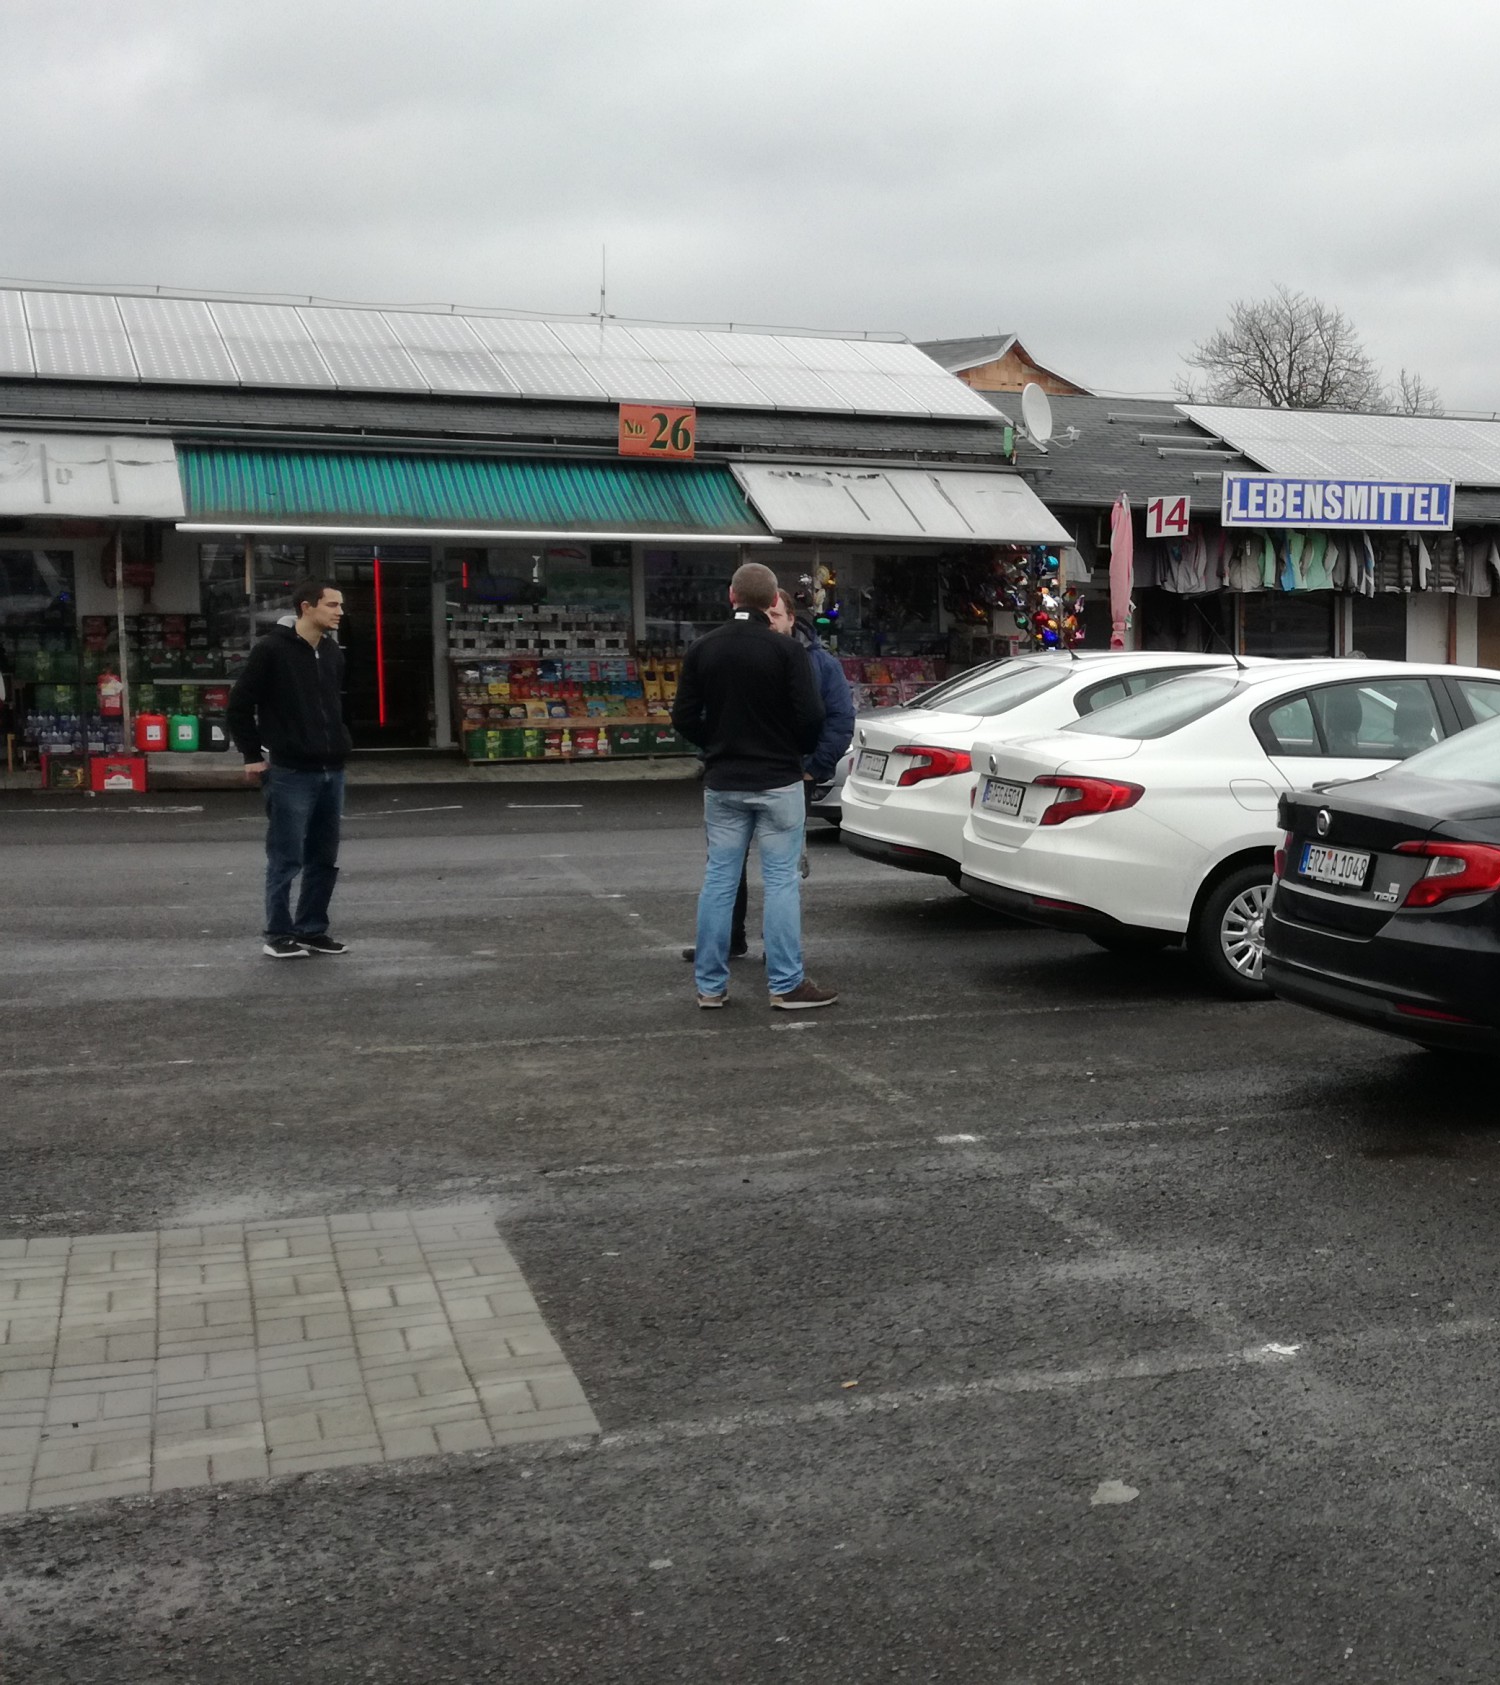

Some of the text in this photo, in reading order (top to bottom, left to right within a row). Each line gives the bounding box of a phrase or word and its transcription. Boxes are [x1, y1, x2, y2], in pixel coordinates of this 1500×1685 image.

[623, 412, 692, 452] No. 26
[1148, 497, 1188, 533] 14
[1231, 481, 1445, 521] LEBENSMITTEL
[1307, 848, 1326, 873] ERZ
[1330, 853, 1338, 876] A
[1338, 854, 1367, 881] 1048
[1373, 891, 1398, 904] TIPO
